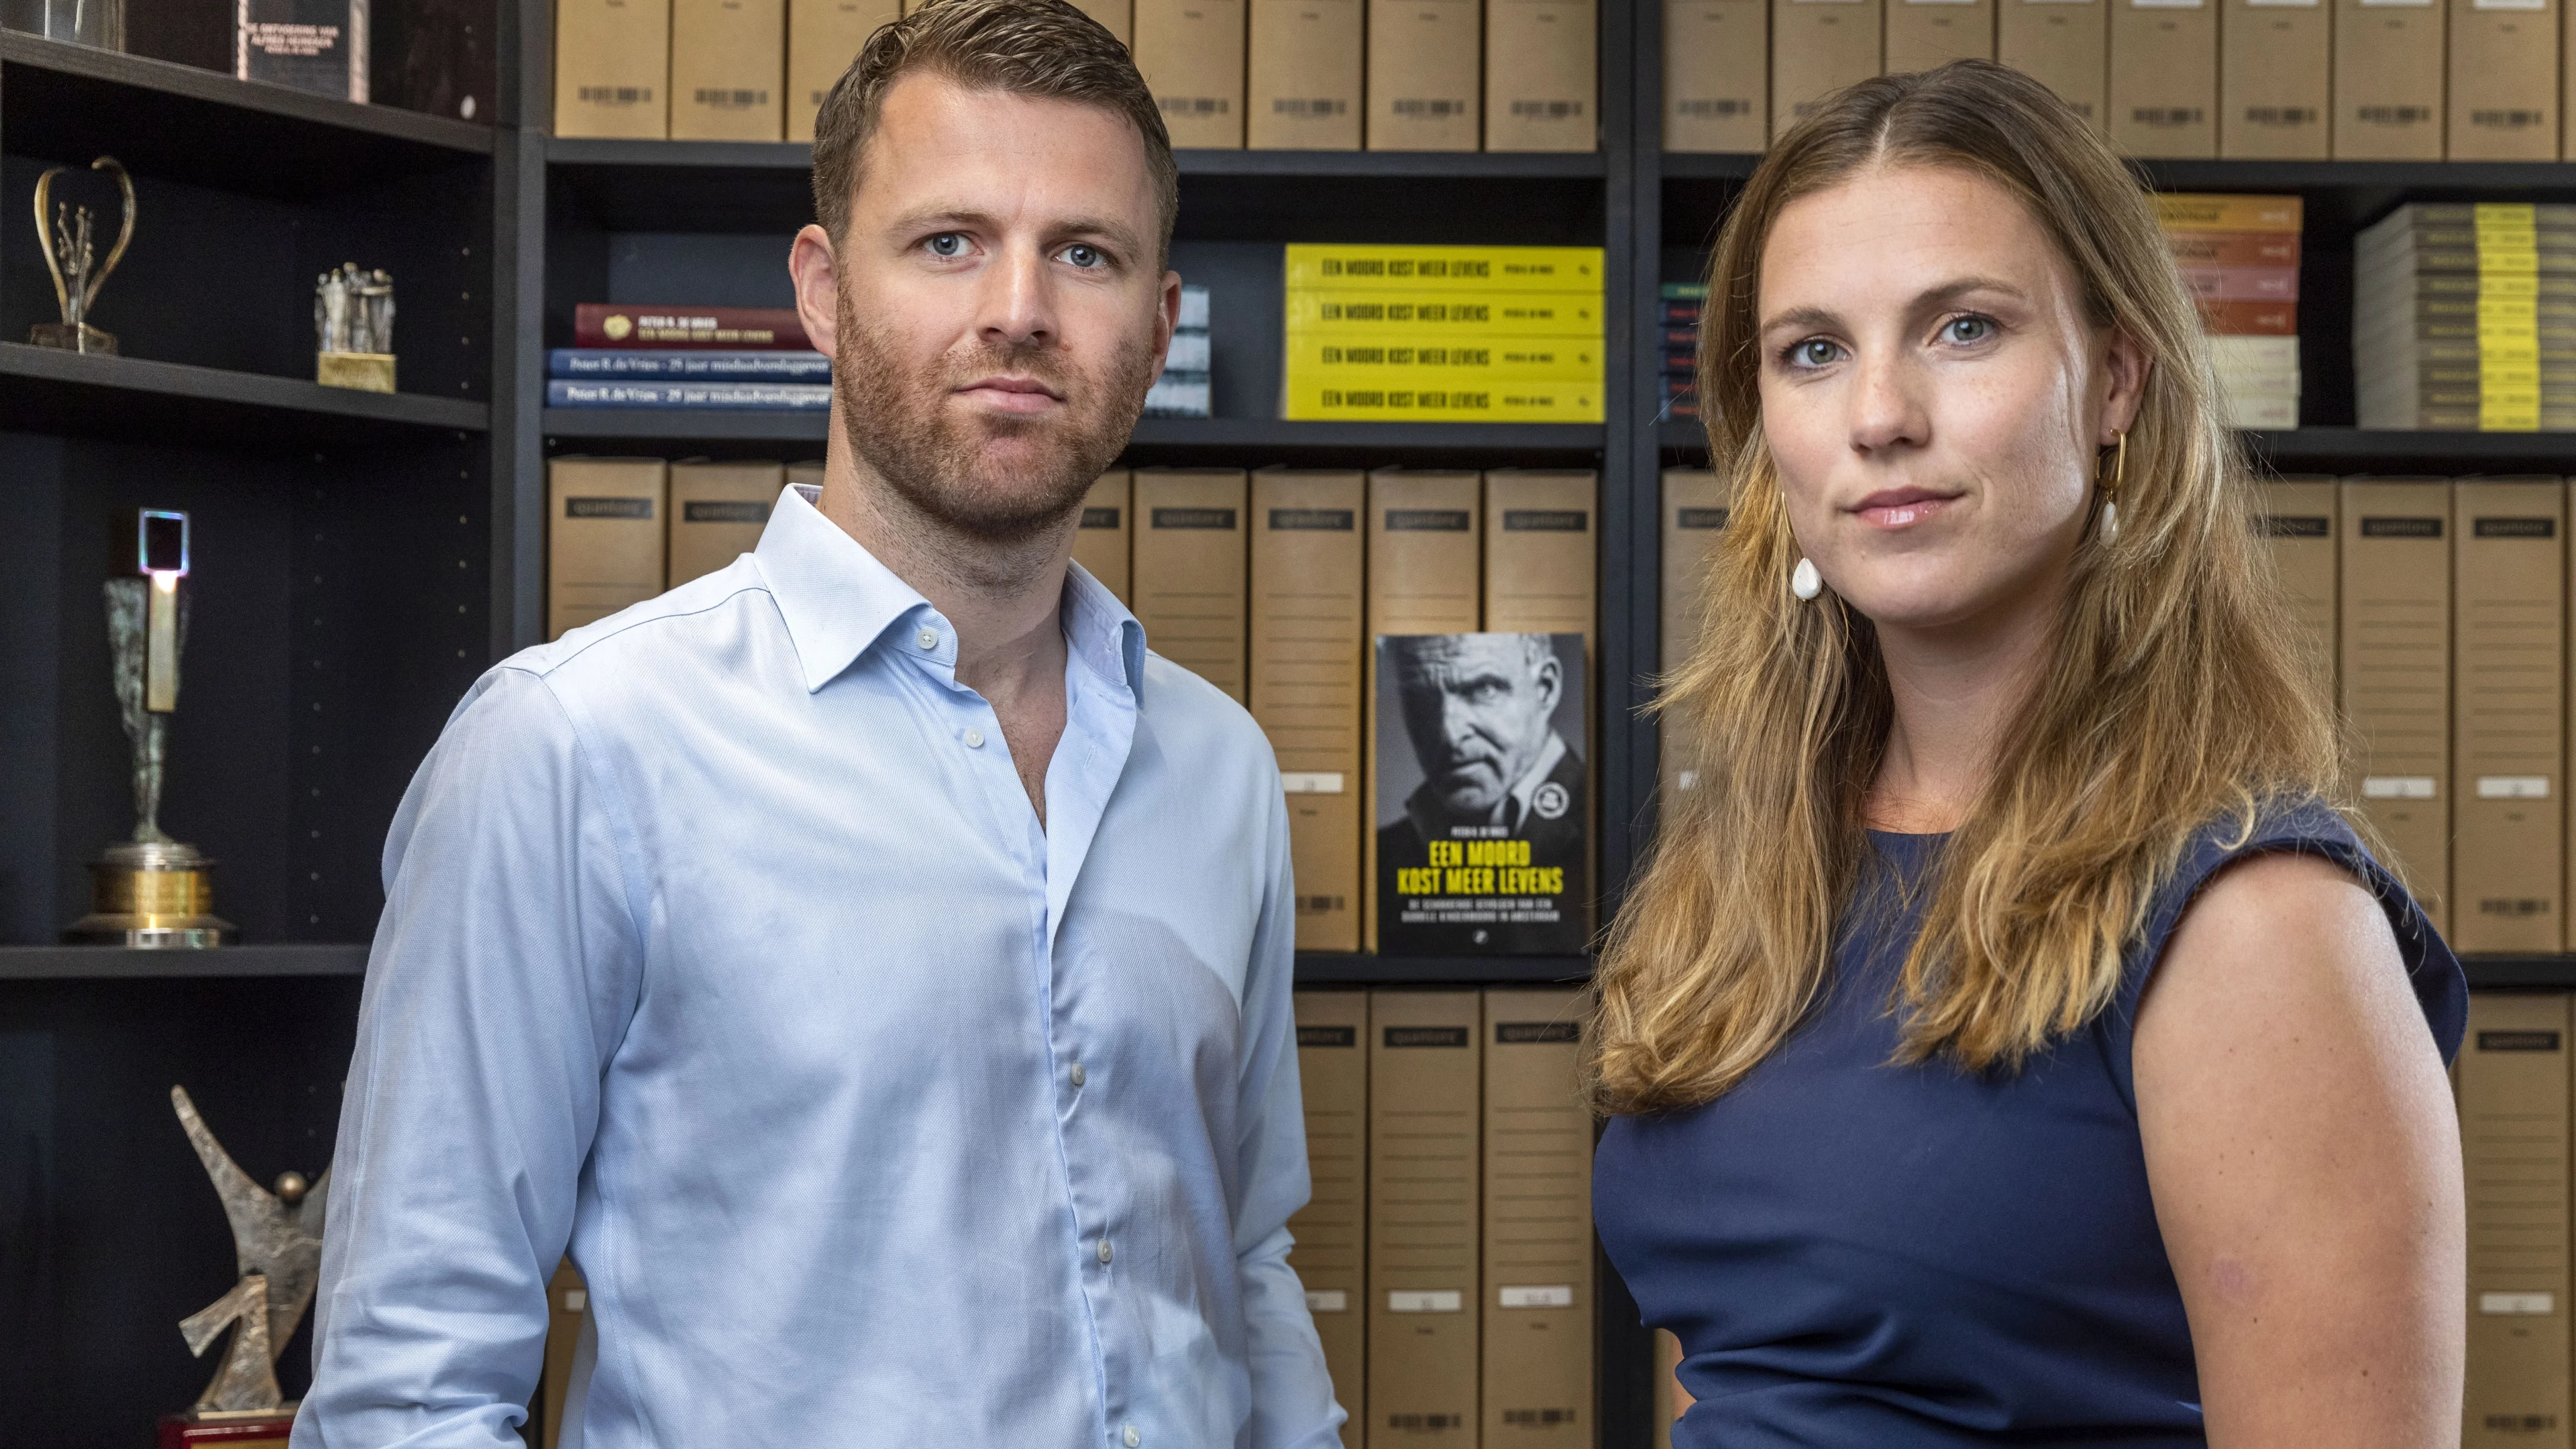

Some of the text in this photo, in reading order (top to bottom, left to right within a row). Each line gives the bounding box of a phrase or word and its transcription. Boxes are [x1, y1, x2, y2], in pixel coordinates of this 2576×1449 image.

[1322, 259, 1342, 277] EEN
[1346, 260, 1385, 278] MOORD
[1388, 260, 1415, 278] KOST
[1417, 260, 1447, 278] MEER
[1450, 261, 1490, 279] LEVENS
[1322, 303, 1342, 321] EEN
[1346, 304, 1385, 322] MOORD
[1388, 304, 1415, 322] KOST
[1417, 305, 1447, 323] MEER
[1450, 305, 1490, 323] LEVENS
[570, 358, 600, 372] Peter
[614, 358, 627, 372] de
[629, 358, 659, 372] Vries
[668, 359, 683, 372] 25
[685, 359, 708, 375] jaar
[1322, 347, 1342, 365] EEN
[1346, 347, 1385, 366] MOORD
[1388, 347, 1415, 366] KOST
[1417, 348, 1447, 366] MEER
[1450, 349, 1490, 367] LEVENS
[568, 387, 598, 401] Peter
[612, 388, 626, 401] de
[627, 388, 658, 402] Vries
[667, 388, 682, 402] 25
[684, 389, 708, 405] jaar
[1322, 390, 1342, 408] EEN
[1346, 390, 1385, 409] MOORD
[1388, 390, 1415, 409] KOST
[1417, 391, 1447, 409] MEER
[1450, 392, 1490, 410] LEVENS
[1429, 841, 1531, 867] EEN MOORD
[1397, 867, 1564, 894] KOST MEER LEVENS
